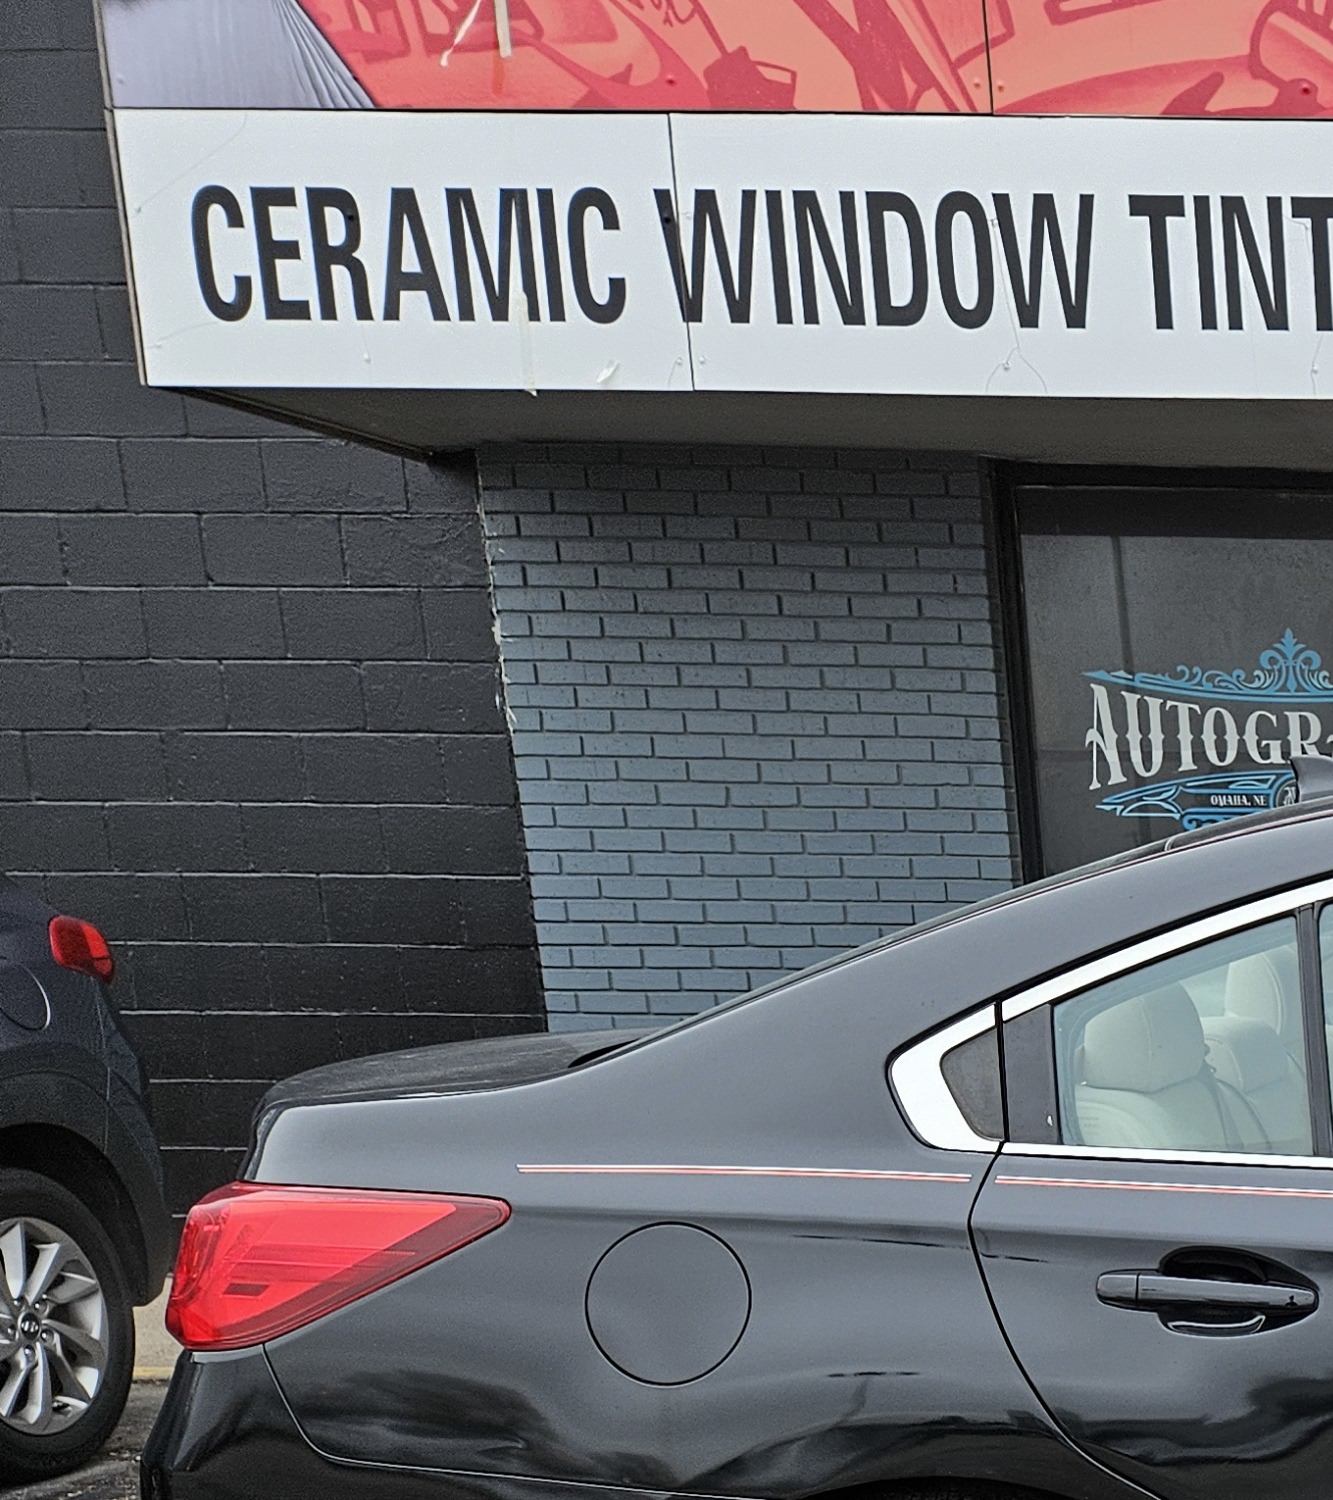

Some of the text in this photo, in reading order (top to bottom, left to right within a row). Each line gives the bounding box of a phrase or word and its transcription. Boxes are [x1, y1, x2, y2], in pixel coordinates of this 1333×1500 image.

[191, 185, 627, 325] CERAMIC
[653, 188, 1095, 330] WINDOW
[1253, 794, 1268, 806] NE
